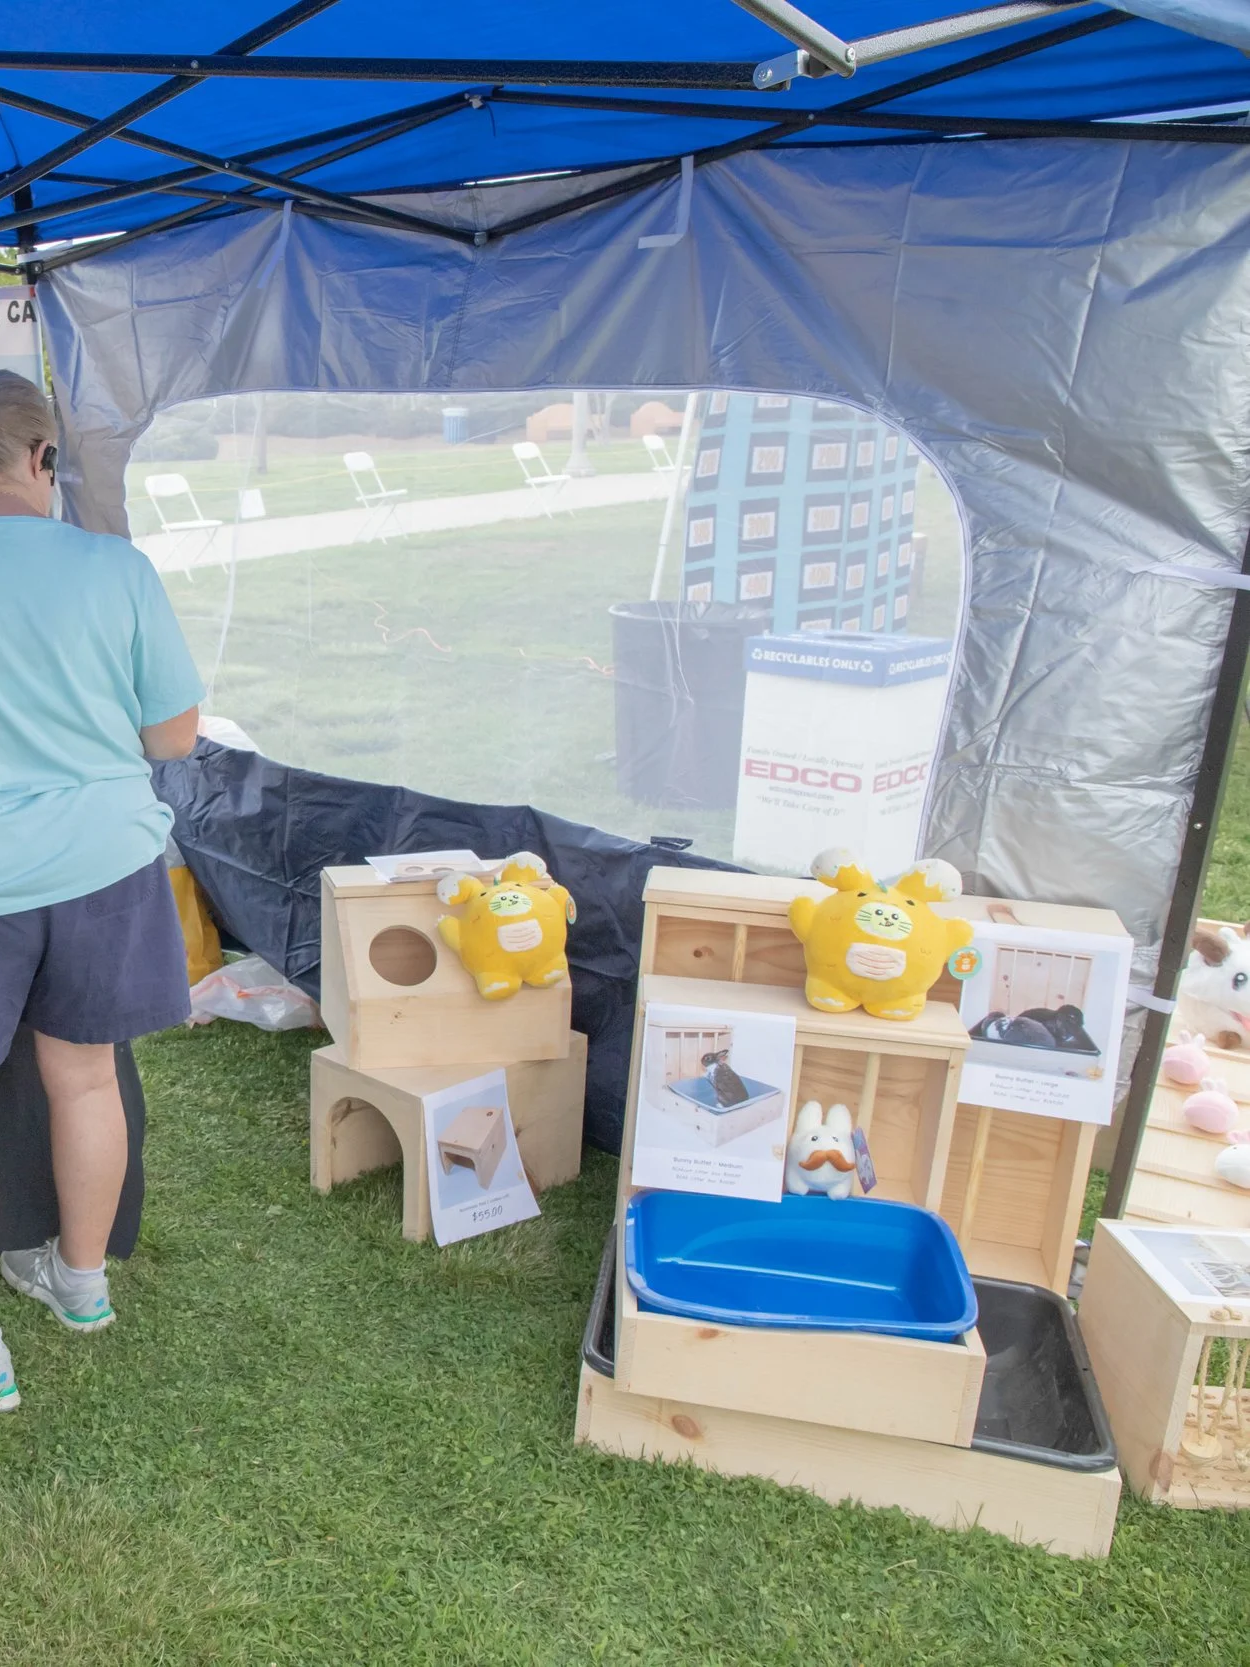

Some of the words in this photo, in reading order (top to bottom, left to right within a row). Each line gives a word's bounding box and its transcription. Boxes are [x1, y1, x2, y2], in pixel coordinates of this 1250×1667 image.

[7, 300, 37, 323] CA
[763, 650, 830, 667] RECYCLABLES
[832, 658, 861, 671] ONLY
[744, 758, 863, 794] EDCO
